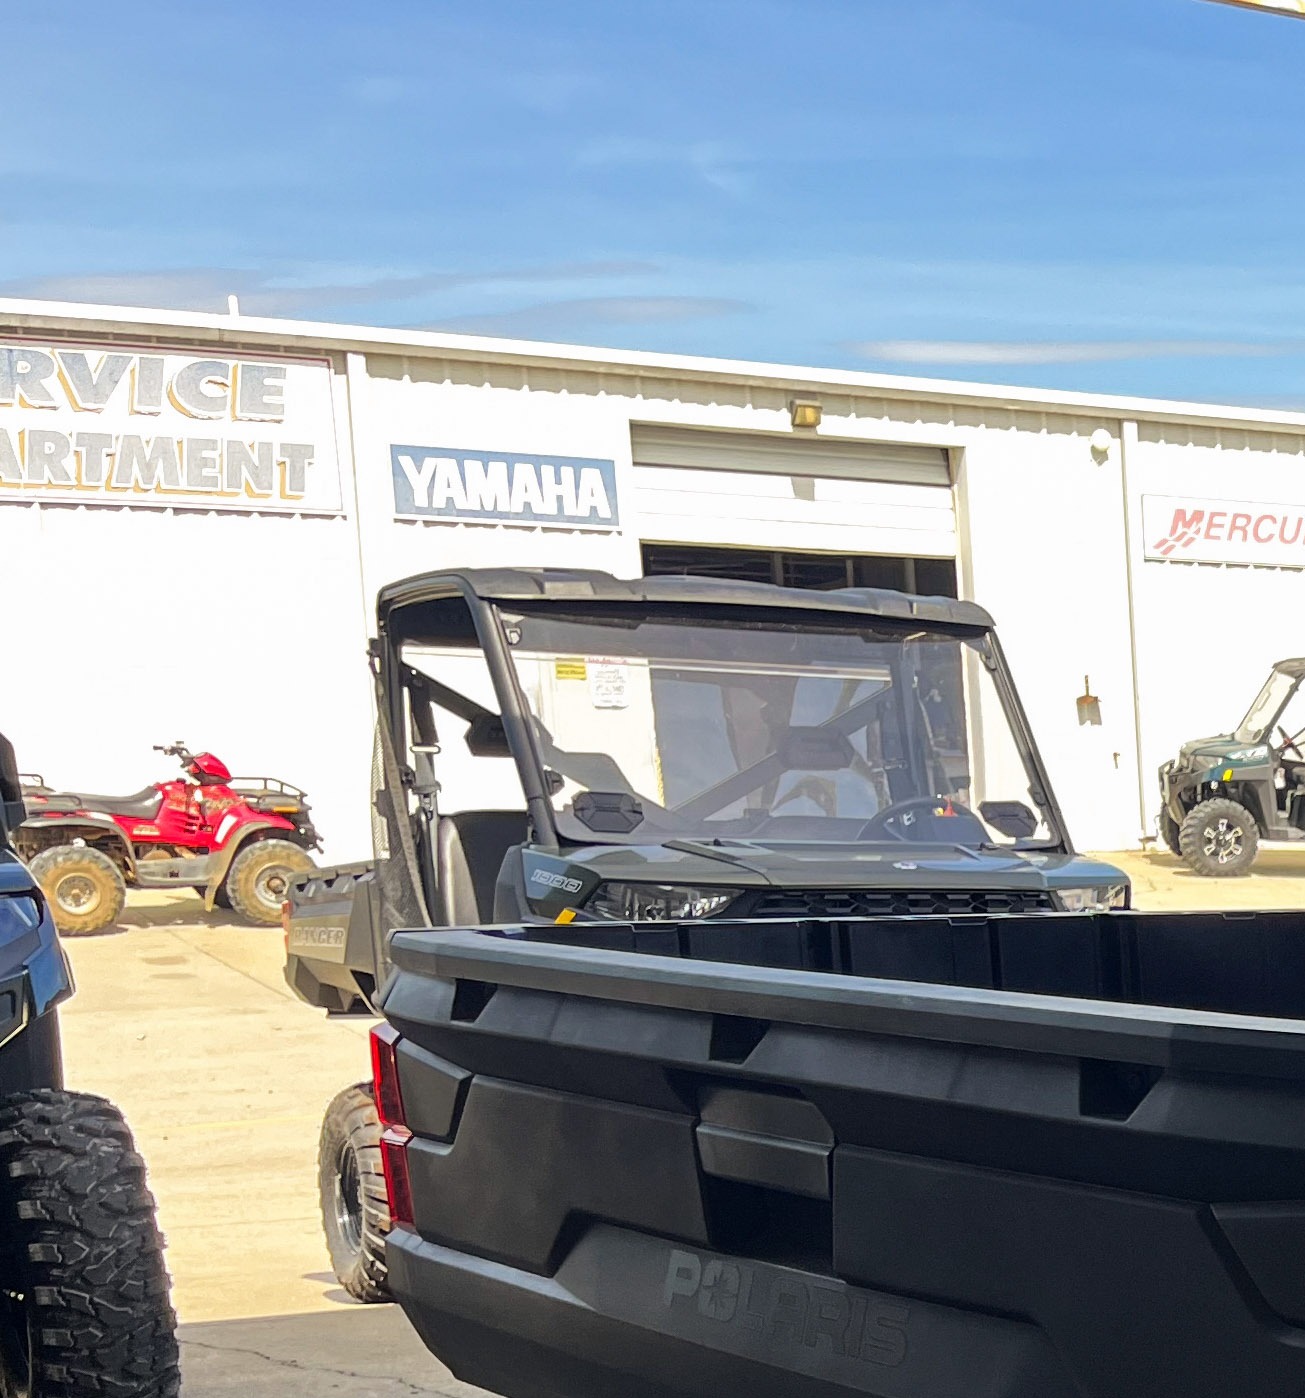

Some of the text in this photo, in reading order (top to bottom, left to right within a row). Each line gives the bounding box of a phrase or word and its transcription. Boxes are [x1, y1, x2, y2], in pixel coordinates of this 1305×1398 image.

[0, 348, 287, 419] RVICE
[398, 455, 612, 518] YAMAHA
[531, 868, 583, 894] 1000
[664, 1249, 911, 1367] POLARIS
